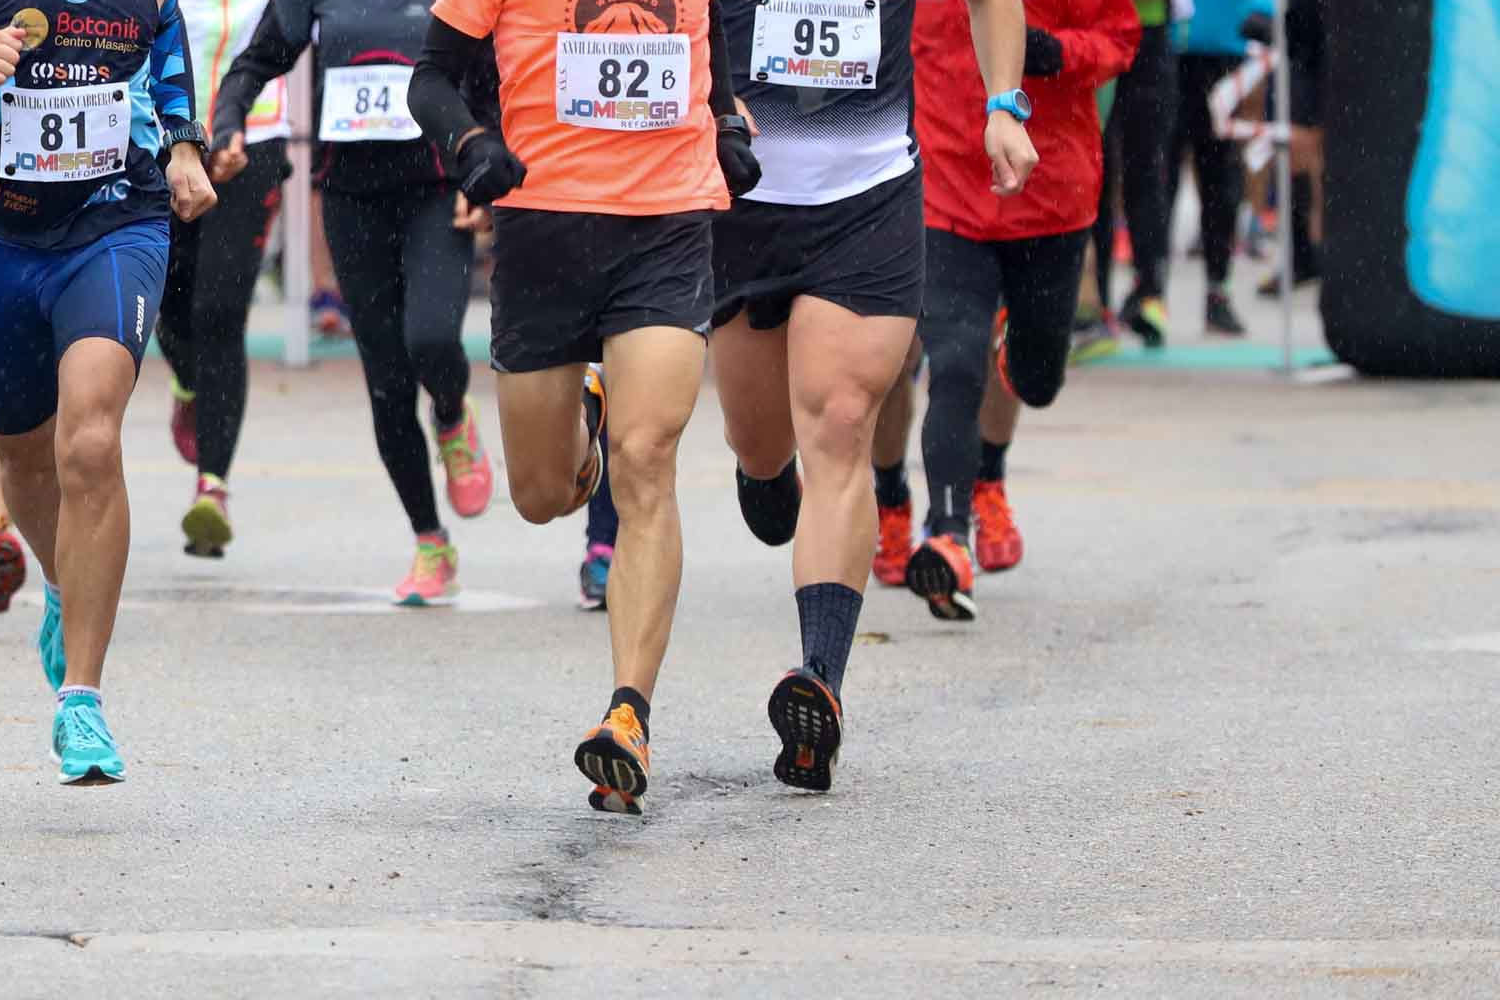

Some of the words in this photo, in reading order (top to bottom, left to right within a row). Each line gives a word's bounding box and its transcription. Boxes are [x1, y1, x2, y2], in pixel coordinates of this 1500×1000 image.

[804, 2, 827, 17] CROSS
[56, 11, 140, 40] Botanik
[54, 35, 92, 48] Centro
[794, 18, 840, 57] 95
[587, 40, 606, 55] LIGA
[608, 41, 636, 56] CROSS
[760, 56, 868, 78] JOMISAGA
[598, 59, 650, 98] 82
[662, 69, 676, 90] B
[813, 78, 860, 86] REFORMA
[29, 96, 47, 110] LIGA
[49, 96, 75, 109] CROSS
[76, 92, 123, 107] CABRERI
[356, 86, 390, 114] 84
[565, 99, 678, 119] JOMISAGA
[108, 114, 118, 127] B
[40, 112, 86, 151] 81
[13, 148, 119, 171] JOMISAGA
[64, 166, 114, 178] REFORMA
